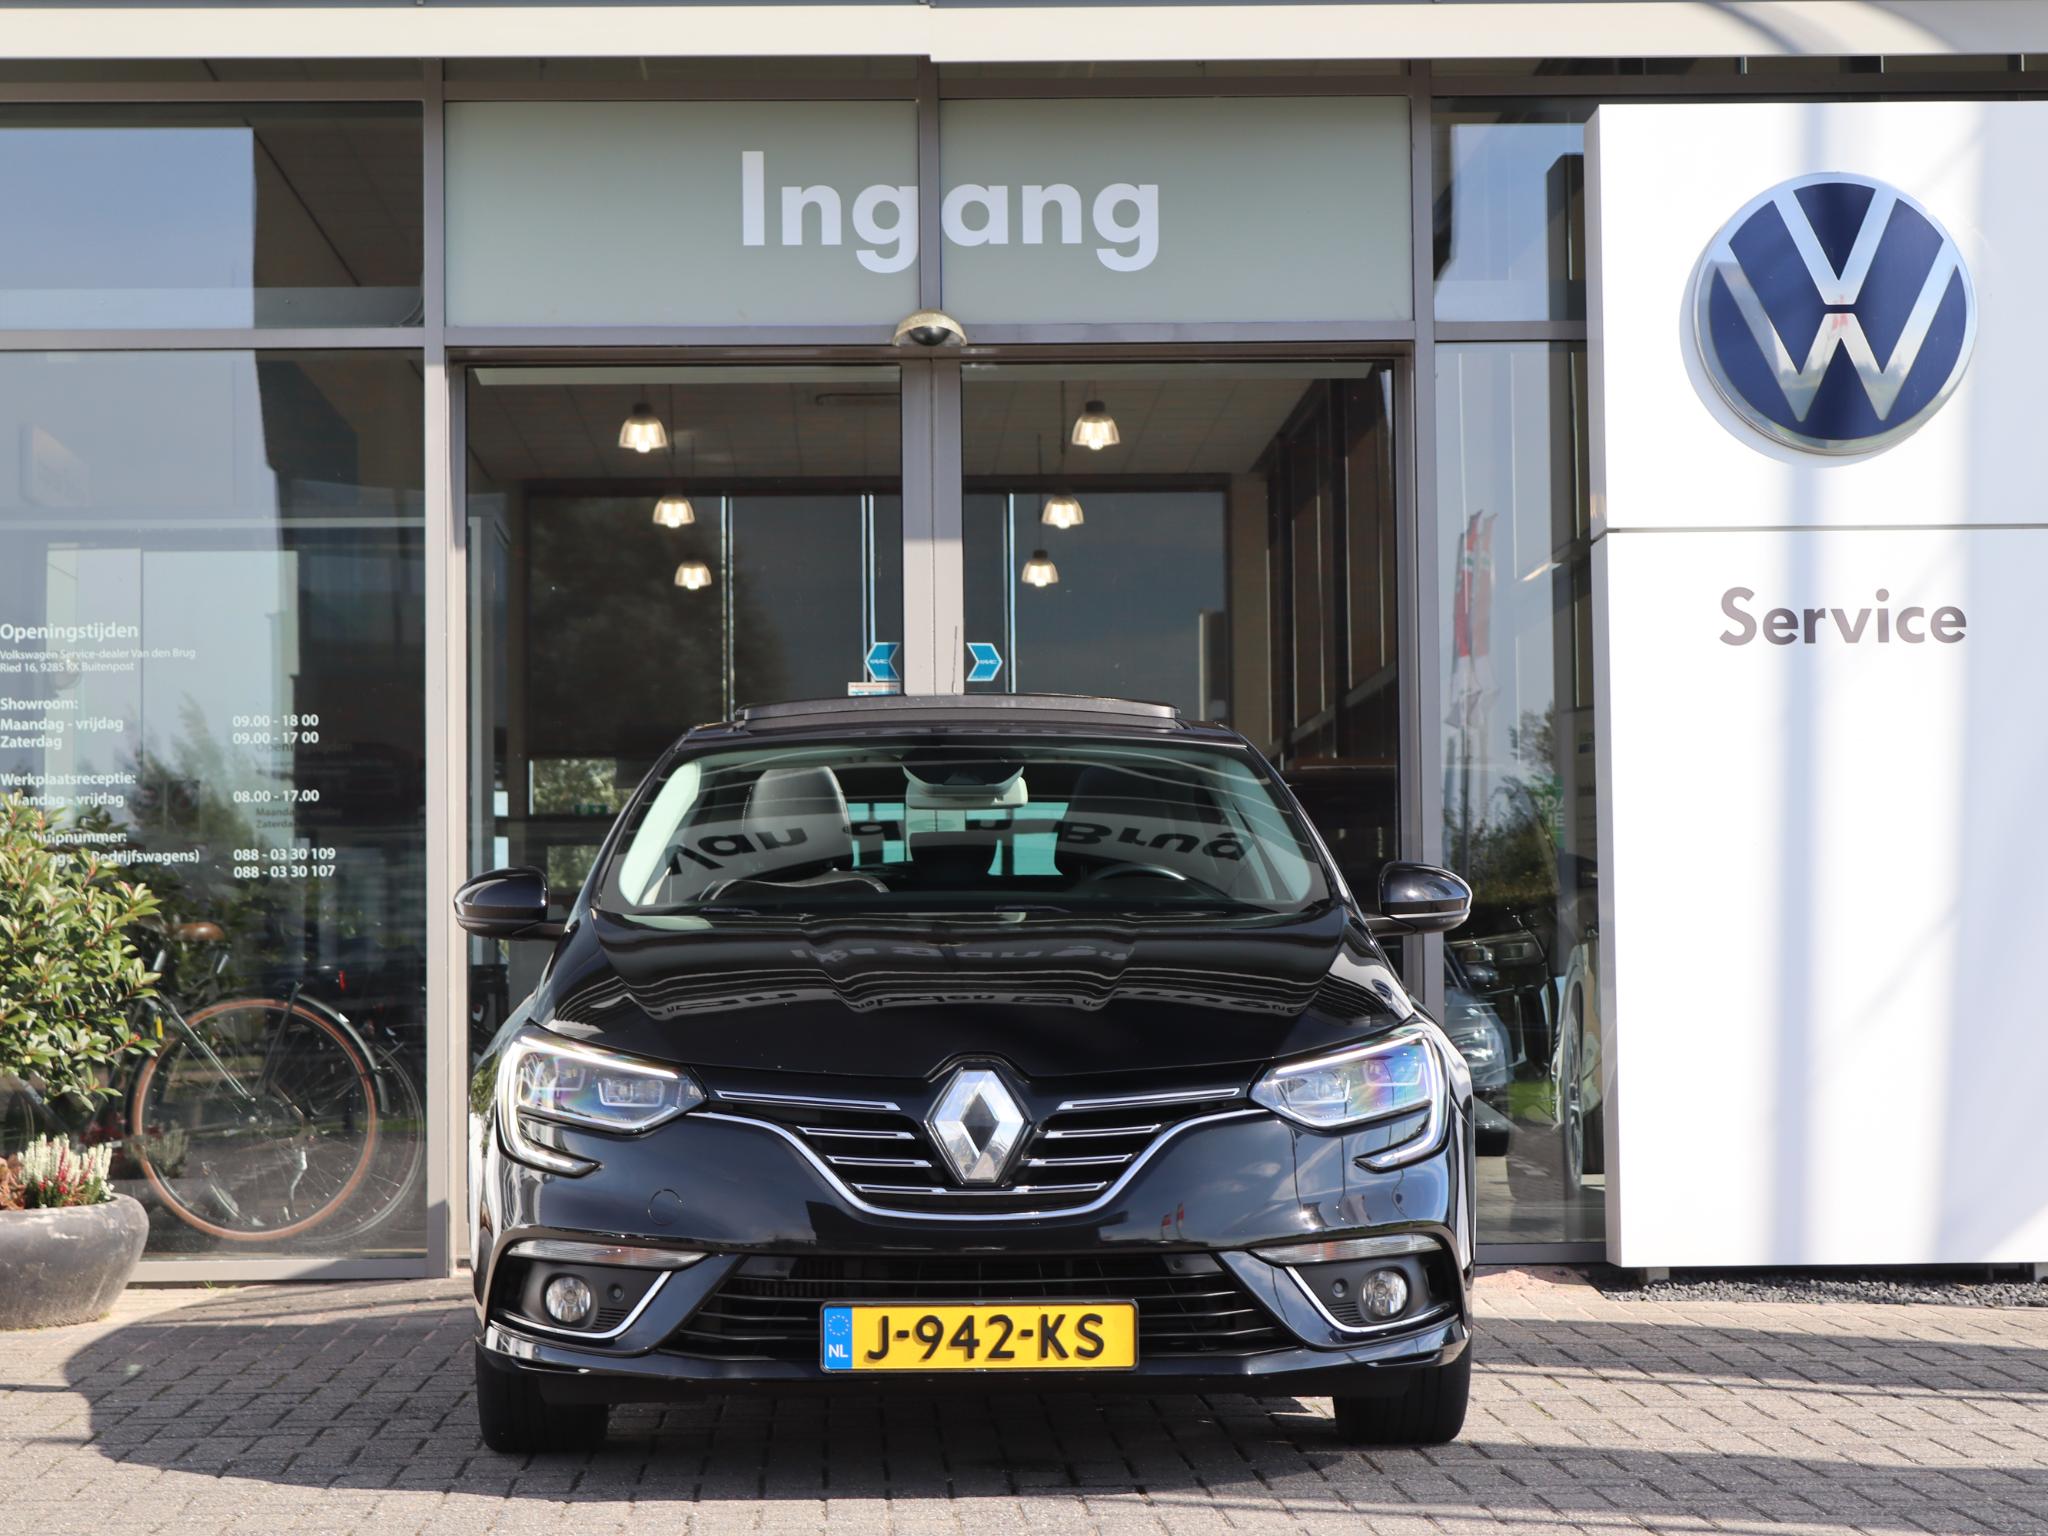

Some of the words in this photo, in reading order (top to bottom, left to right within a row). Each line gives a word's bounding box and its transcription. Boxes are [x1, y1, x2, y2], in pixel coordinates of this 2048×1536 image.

[742, 150, 1160, 274] Ingang
[1719, 586, 1967, 647] Service
[0, 622, 139, 643] Openingstijden
[0, 650, 58, 661] Volkswagen
[60, 649, 130, 660] Service-dealer
[131, 649, 149, 659] Van
[151, 649, 171, 658] den
[173, 649, 196, 660] Brug
[0, 662, 22, 673] Ried
[24, 663, 39, 674] 16,
[81, 662, 135, 674] Buitenpost
[0, 697, 79, 711] Showroom:
[0, 718, 64, 733] Maandag
[75, 717, 124, 732] vrijdag
[232, 715, 271, 728] 09.00
[0, 735, 63, 750] Zaterdag
[232, 732, 271, 744] 09.00
[0, 772, 137, 788] Werkplaatsreceptie:
[76, 792, 124, 807] vrijdag
[233, 790, 271, 803] 08.00
[282, 789, 320, 802] 17.00
[89, 849, 200, 865] Bedrijfswagens)
[233, 849, 260, 861] 088
[270, 848, 287, 860] 03
[290, 848, 308, 860] 30
[311, 847, 336, 860] 109
[233, 866, 260, 879] 088
[270, 866, 287, 878] 03
[290, 865, 308, 878] 30
[311, 865, 336, 877] 107
[867, 1312, 1105, 1361] J-942-KS
[828, 1343, 849, 1358] NL
